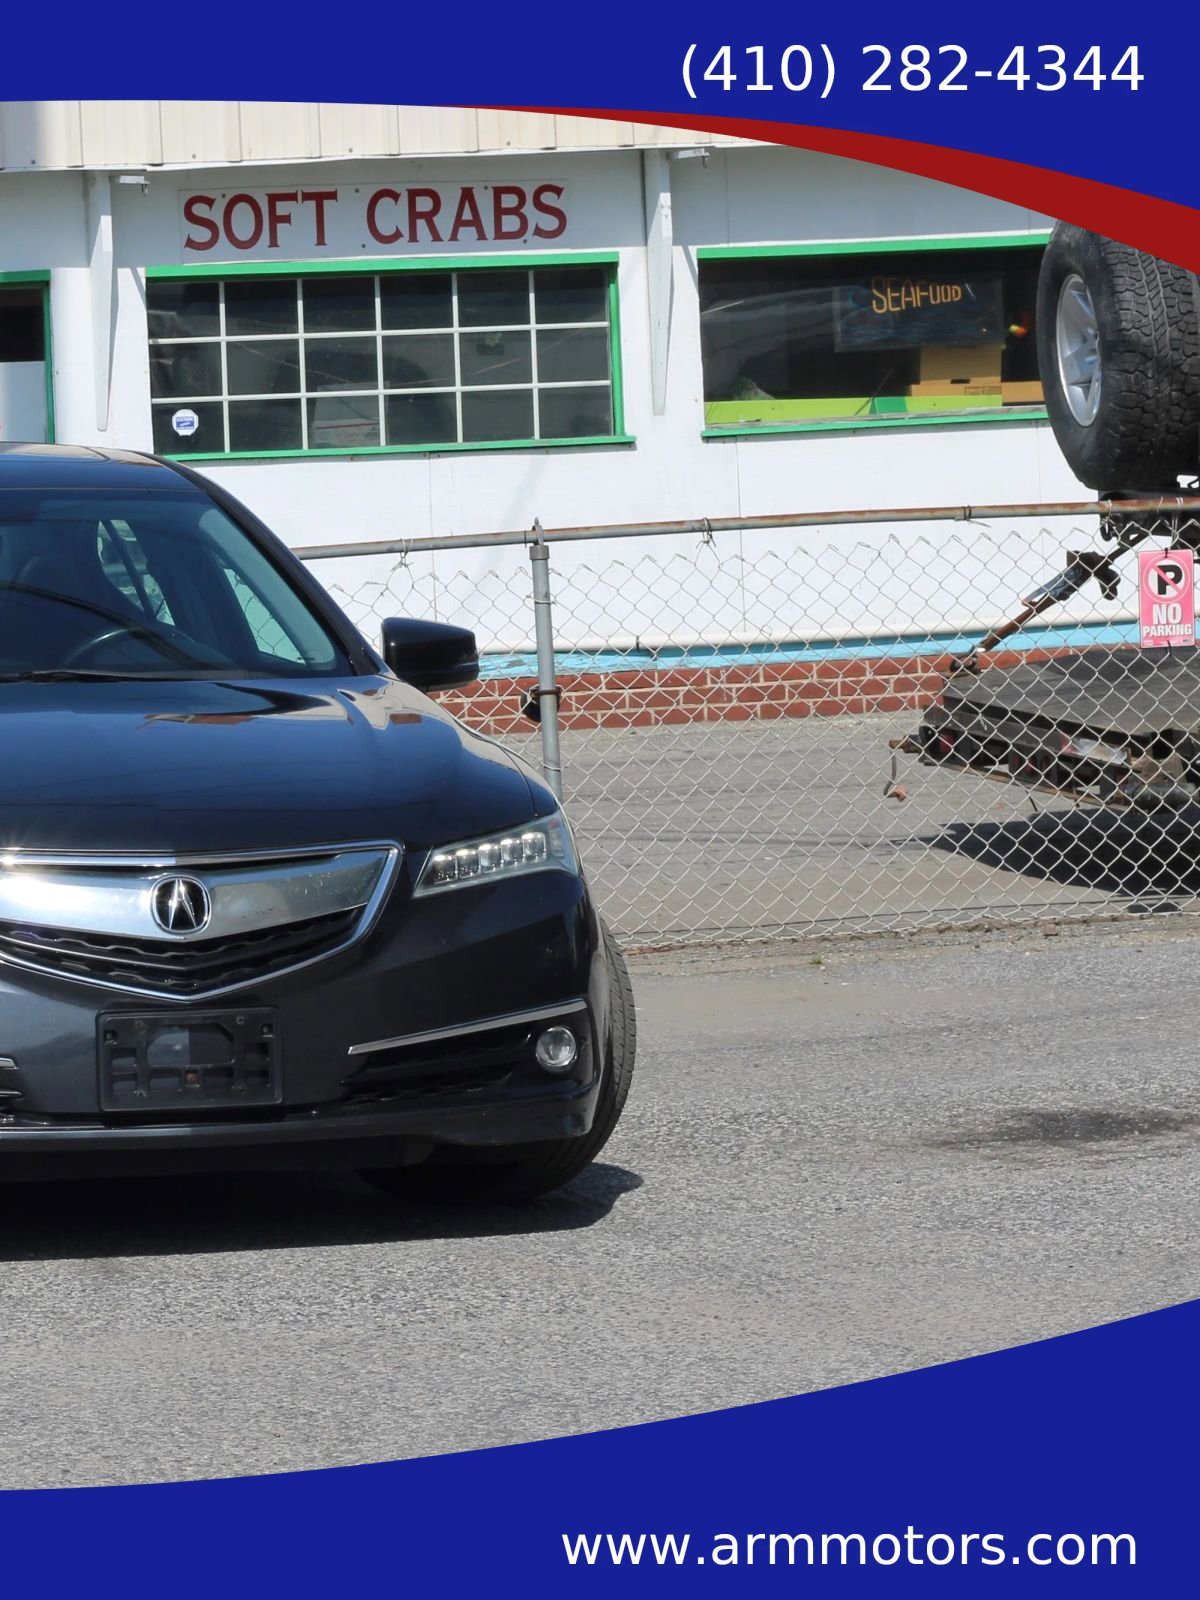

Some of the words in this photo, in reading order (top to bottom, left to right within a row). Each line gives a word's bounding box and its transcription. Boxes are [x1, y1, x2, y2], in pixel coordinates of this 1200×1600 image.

[183, 188, 338, 251] SOFT
[365, 183, 568, 245] CRABS
[871, 274, 962, 314] SEAFOOD
[1152, 603, 1182, 625] NO
[1143, 623, 1192, 637] PARKING
